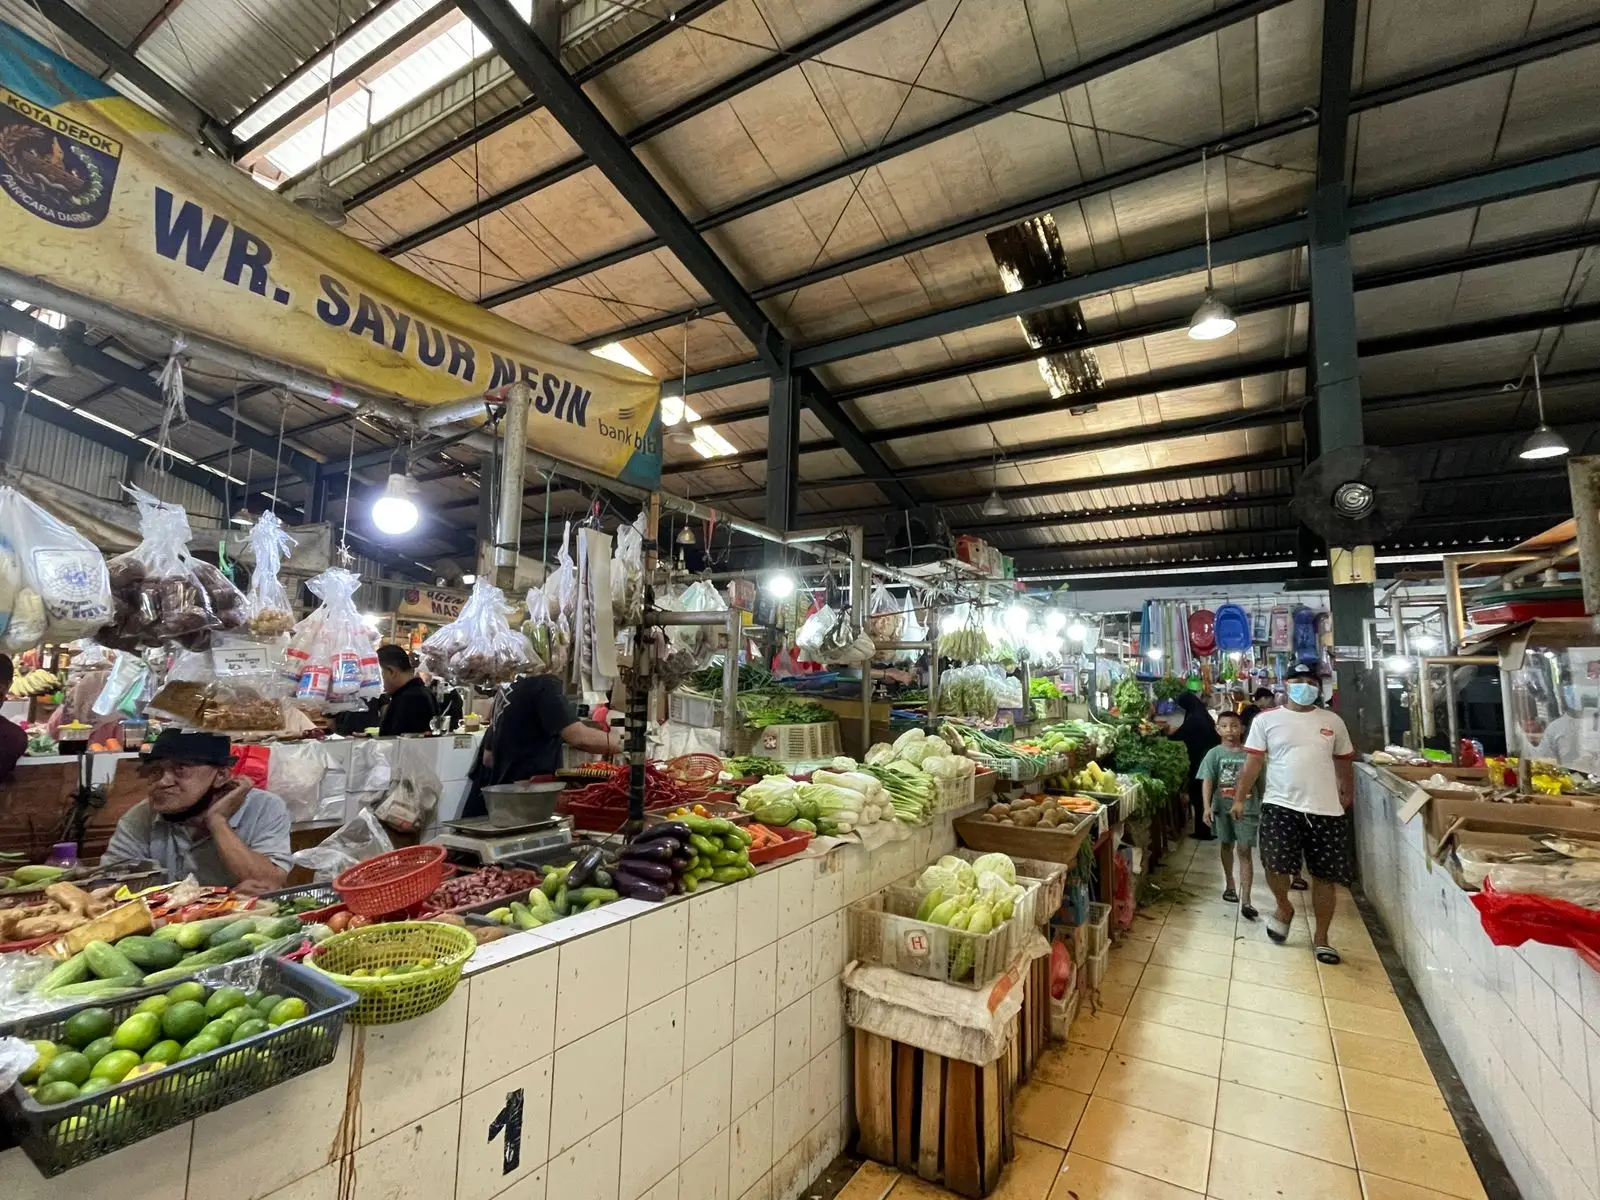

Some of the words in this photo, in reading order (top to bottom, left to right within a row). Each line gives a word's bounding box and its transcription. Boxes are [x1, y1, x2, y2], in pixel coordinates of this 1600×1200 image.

[7, 94, 52, 127] KOTA
[56, 120, 113, 154] DEPOK
[155, 186, 291, 306] WR.
[316, 273, 476, 383] SAYUR
[488, 351, 592, 428] NESIN
[598, 418, 632, 446] bank
[487, 1088, 525, 1176] 1
